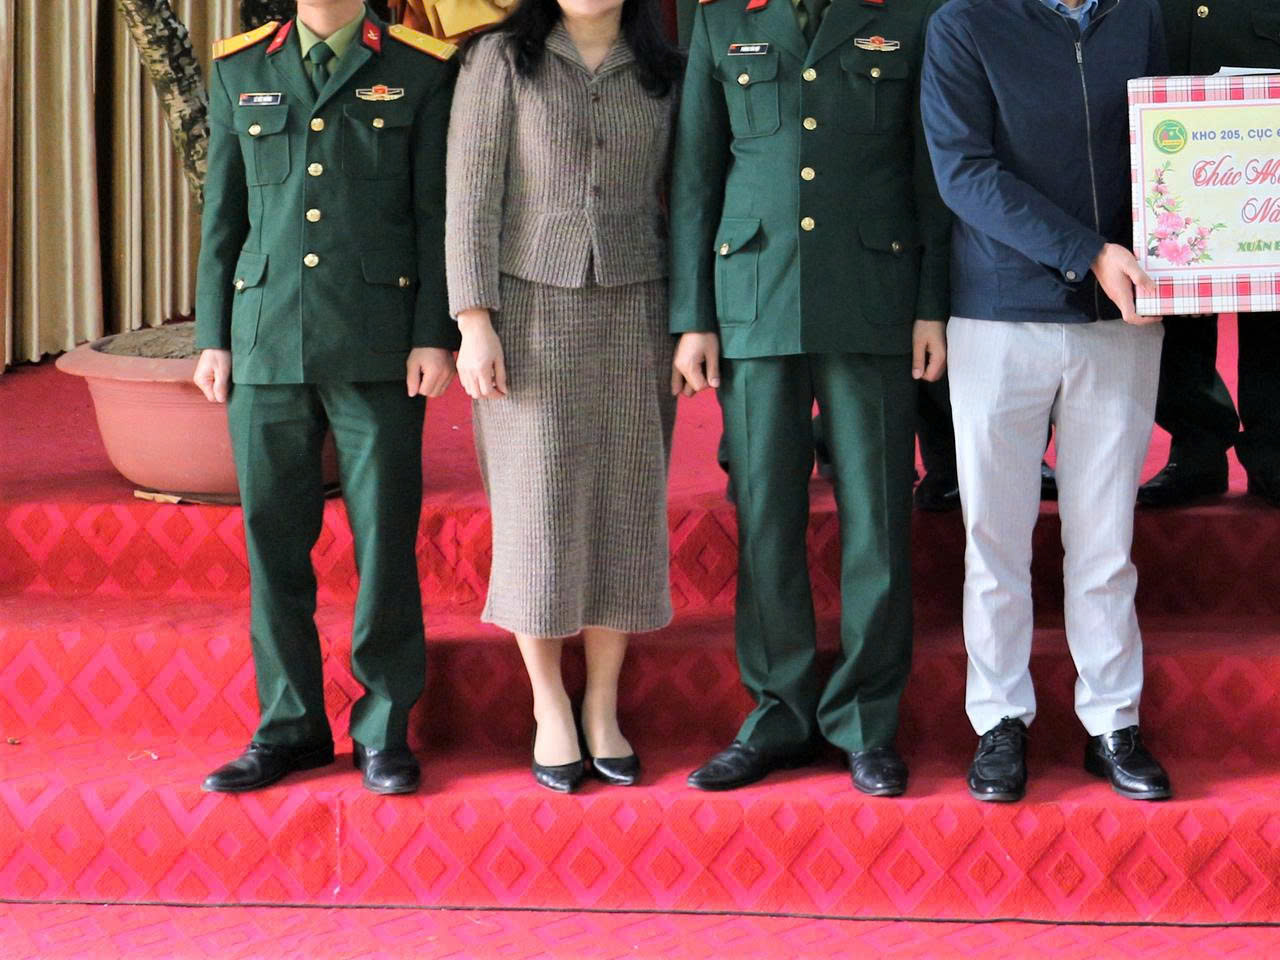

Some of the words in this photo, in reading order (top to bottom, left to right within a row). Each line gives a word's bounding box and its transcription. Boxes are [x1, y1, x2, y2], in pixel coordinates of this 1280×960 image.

[1192, 131, 1216, 141] KHO
[1220, 130, 1244, 141] 205,
[1247, 128, 1272, 141] CỤC
